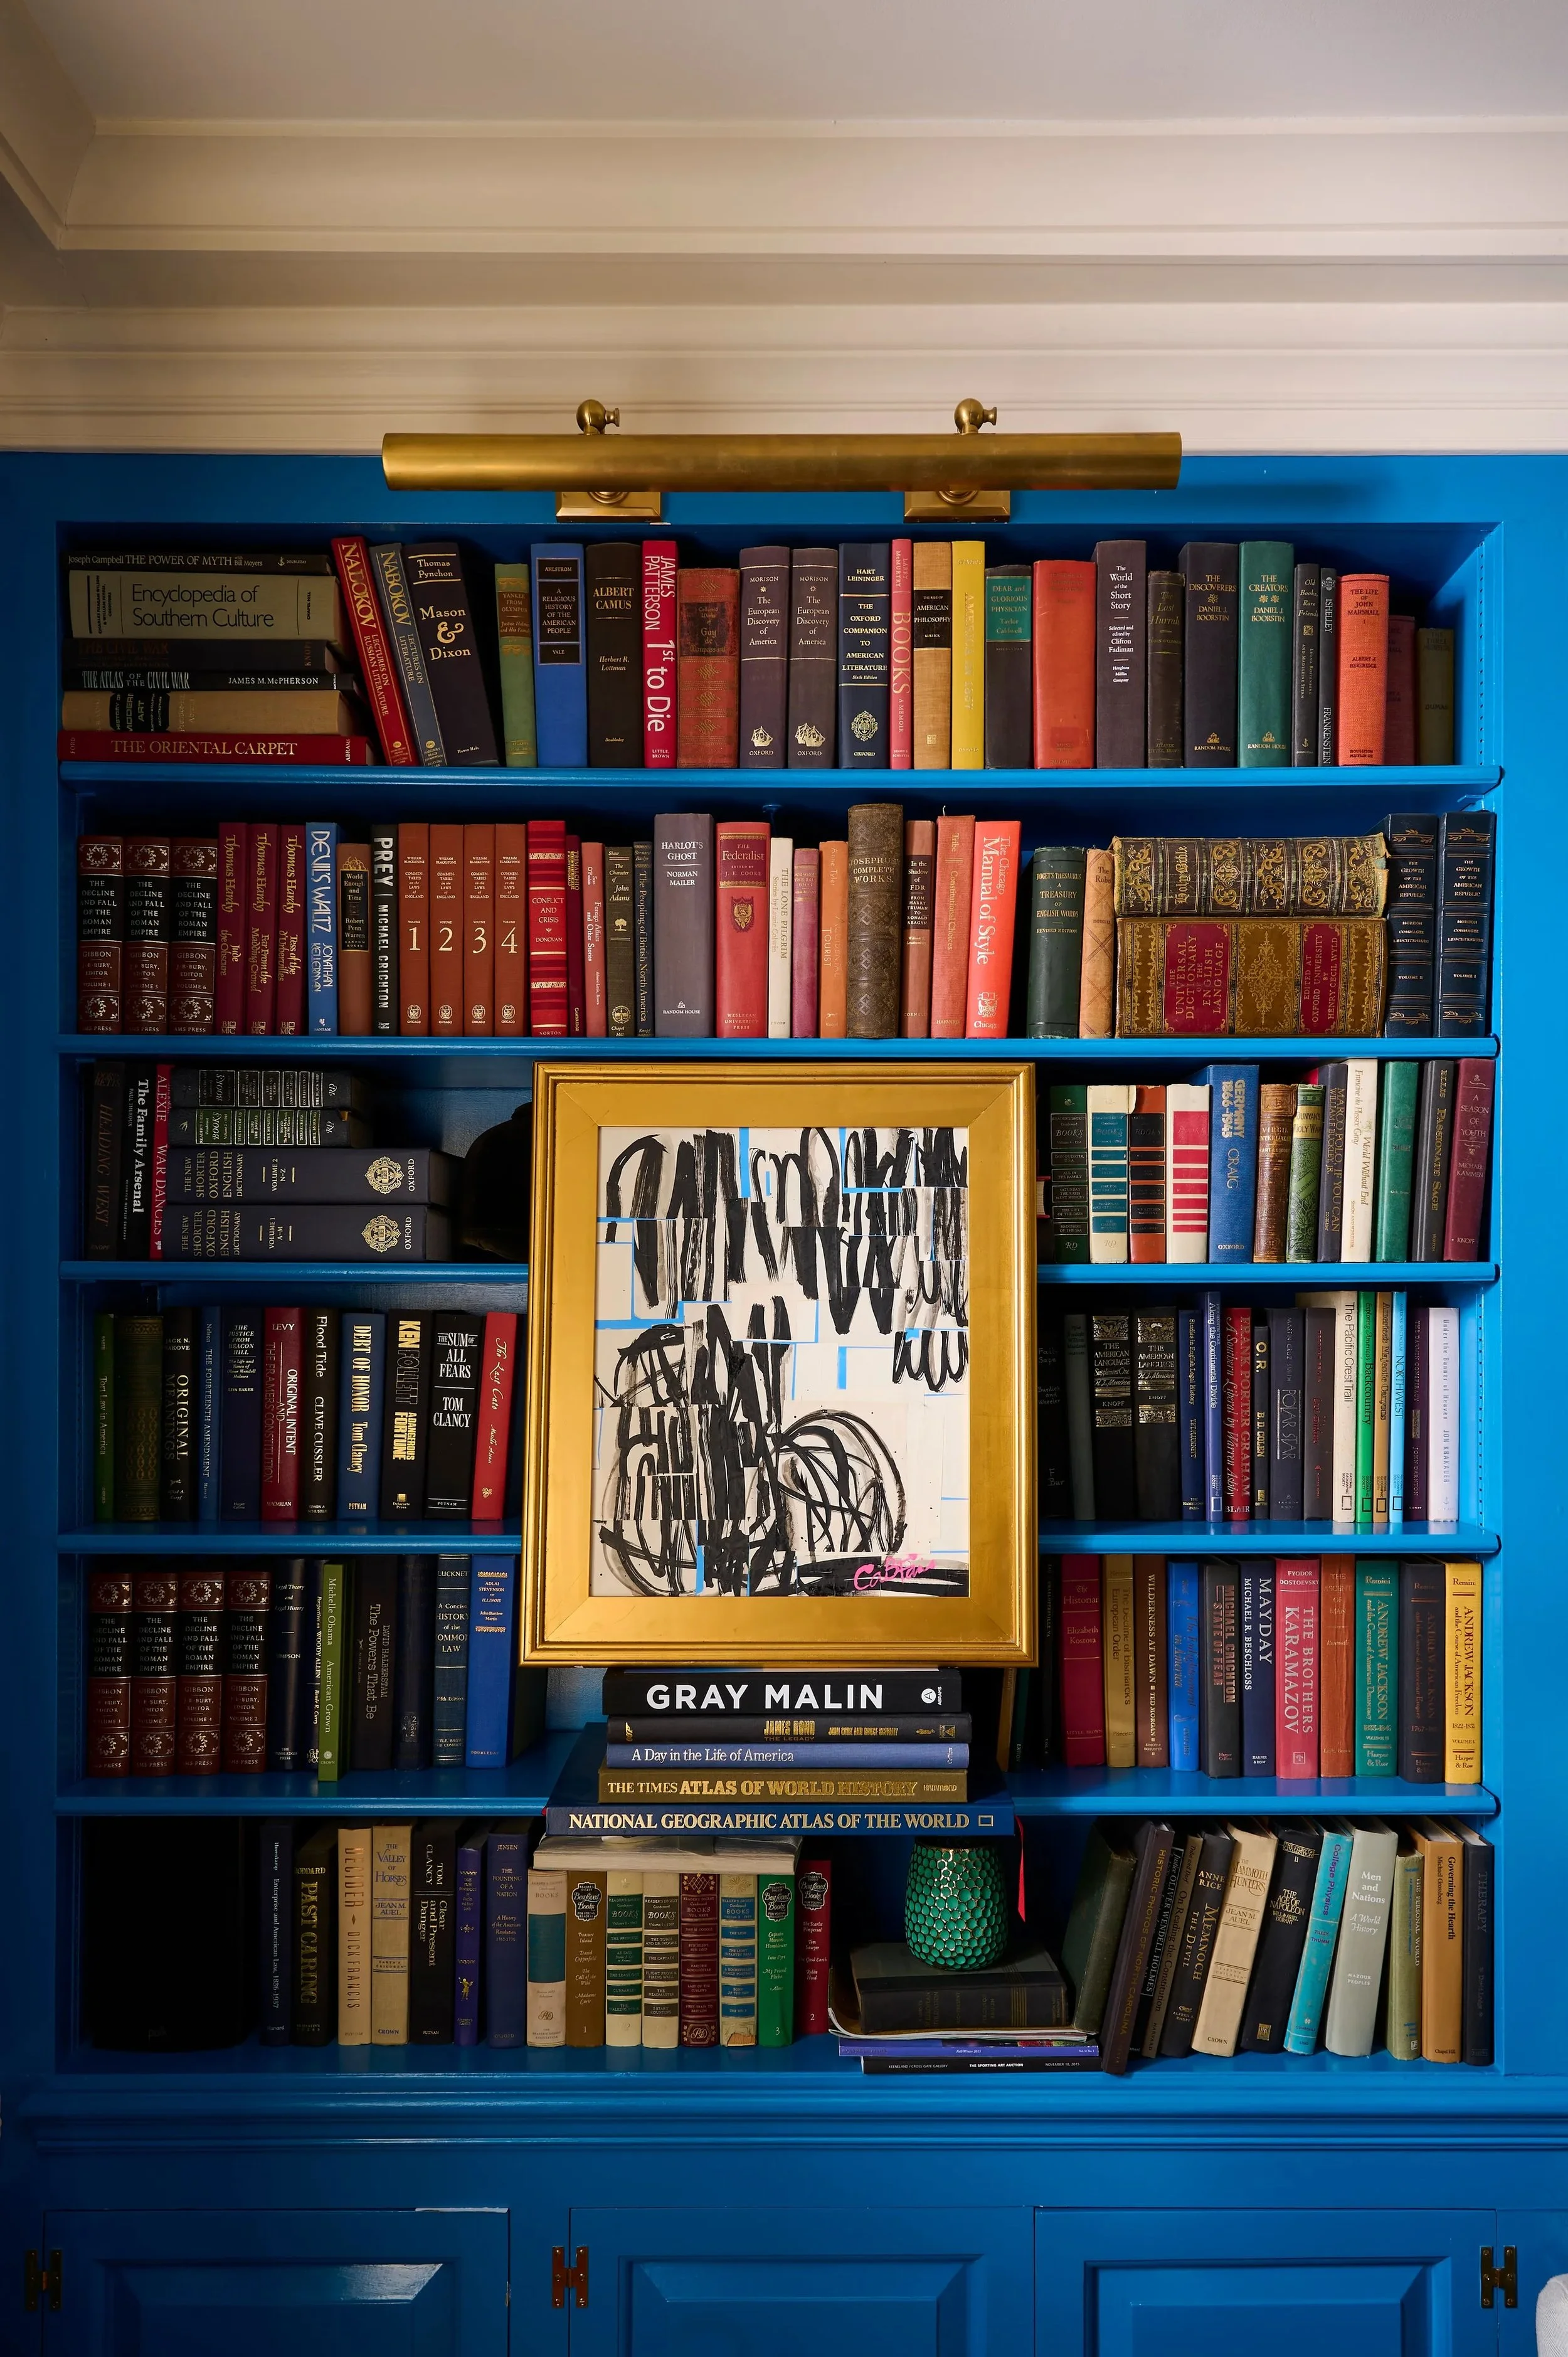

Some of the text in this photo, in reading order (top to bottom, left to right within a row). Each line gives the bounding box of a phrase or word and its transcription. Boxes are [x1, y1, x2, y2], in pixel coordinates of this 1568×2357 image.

[68, 555, 232, 566] Joseph Campbell THE POWER OF MYTH
[416, 559, 450, 568] Thomas
[418, 569, 453, 578] Pynchon
[660, 556, 675, 598] JAMES
[1110, 573, 1133, 581] World
[132, 584, 260, 607] Encyclopedia of
[593, 587, 634, 597] ALBERT
[596, 600, 632, 610] CAMUS
[645, 556, 660, 630] PATTERSON
[1110, 591, 1131, 600] Short
[1111, 601, 1130, 610] Story
[133, 607, 274, 627] Southern Culture
[420, 605, 466, 620] Mason
[437, 622, 464, 644] &
[429, 646, 471, 660] Dixon
[892, 612, 911, 694] BOOKS
[647, 640, 675, 732] 1st to Die
[112, 739, 297, 756] THE ORIENTAL CARPET
[374, 837, 394, 887] PREY
[667, 852, 697, 861] GHOST
[723, 850, 765, 861] Federalist
[282, 835, 302, 913] Thomas Hardy
[974, 837, 1000, 965] Manual of Style
[408, 927, 421, 951] 1
[438, 927, 453, 951] 2
[472, 927, 487, 954] 3
[501, 927, 518, 954] 4
[378, 904, 389, 1009] MICHAEL CRICHTON
[1175, 941, 1186, 1015] UNIVERSAL
[1186, 936, 1197, 1019] DICTIONARY
[1202, 948, 1213, 1006] ENGLISH
[1212, 942, 1224, 1014] LANGUAGE
[1221, 1080, 1233, 1138] 1866-1945
[132, 1079, 150, 1213] The Family Arsenal
[154, 1074, 167, 1235] ALEXIE WAR DANCES
[1227, 1148, 1239, 1189] CRAIG
[398, 1320, 421, 1348] KEN
[447, 1333, 468, 1347] SUM
[446, 1349, 467, 1363] ALL
[1343, 1302, 1355, 1402] The Pacific Crest Trail
[439, 1364, 471, 1379] FEARS
[314, 1315, 327, 1482] Flood Tide CLIVE CUSSLER
[347, 1325, 372, 1474] DEBT OF HONOR Tom Clancy
[1394, 1355, 1404, 1419] NORTHWEST
[176, 1374, 189, 1459] ORIGINAL
[442, 1397, 464, 1412] TOM
[433, 1412, 471, 1428] CLANCY
[1280, 1389, 1298, 1460] POLAR STAR
[326, 1577, 336, 1734] Michelle Obama American Grown
[366, 1604, 381, 1719] The Powers That Be
[1285, 1606, 1300, 1734] KARAMAZOV
[1303, 1606, 1313, 1734] THE BROTHERS
[1464, 1606, 1474, 1717] ANDREW JACKSON
[646, 1684, 883, 1710] GRAY MALIN
[632, 1749, 794, 1763] A Day in the Life of America
[608, 1781, 918, 1796] THE TIMES ATLAS OF WORLD HISTORY
[569, 1813, 970, 1830] NATIONAL GEOGRAPHIC ATLAS OF THE WORLD
[425, 1845, 433, 1885] CLANCY
[436, 1863, 444, 1885] TOM
[1198, 1870, 1226, 1882] ANNE
[1323, 1843, 1341, 1916] College Physics
[1362, 1871, 1382, 1882] Men
[1446, 1856, 1456, 1898] Governing
[1199, 1879, 1222, 1891] RICE
[1352, 1892, 1385, 1904] Nations
[1362, 1883, 1379, 1892] and
[418, 1900, 428, 1942] Danger
[439, 1900, 448, 1931] Clear
[300, 1882, 319, 2005] PAST CARING
[428, 1925, 438, 1968] Present
[1182, 1934, 1197, 1968] DEVIL
[1192, 1902, 1219, 1981] MEMNOCH
